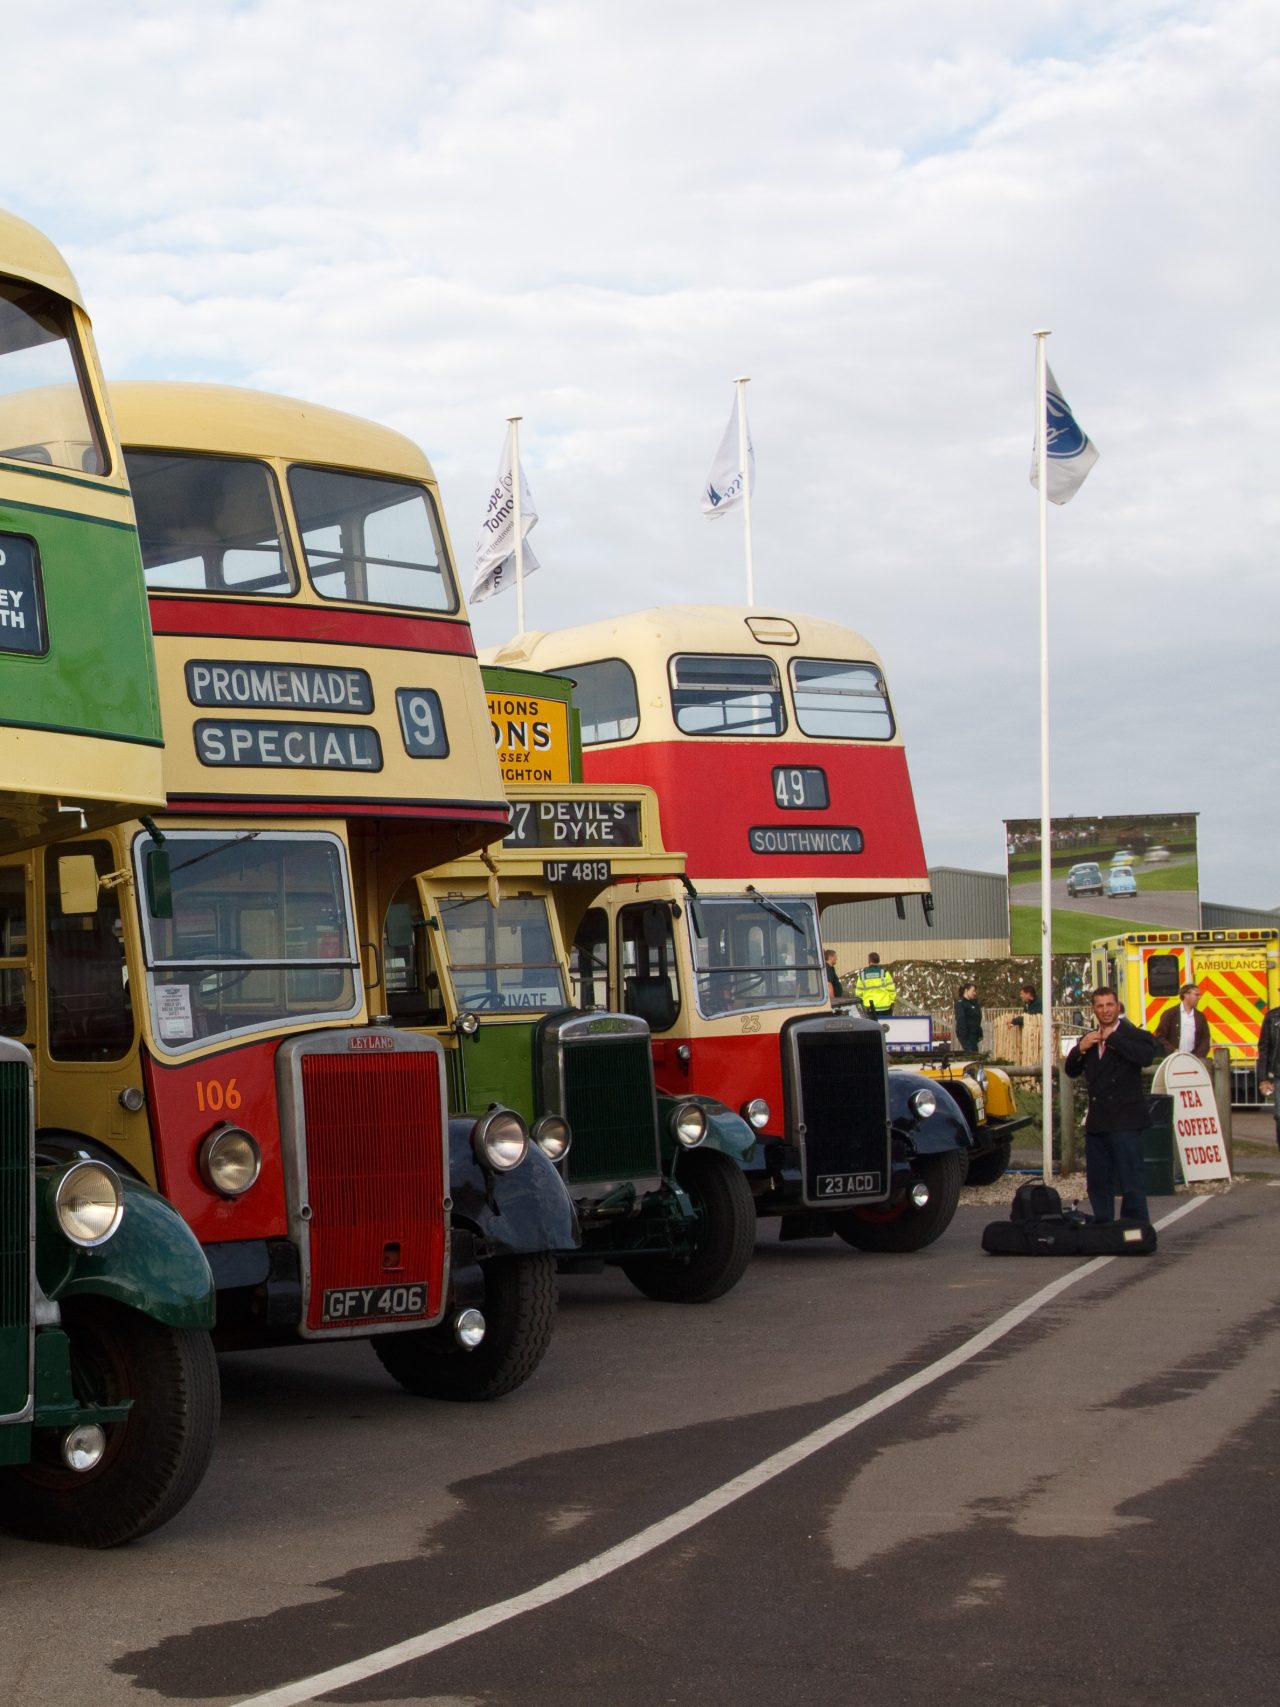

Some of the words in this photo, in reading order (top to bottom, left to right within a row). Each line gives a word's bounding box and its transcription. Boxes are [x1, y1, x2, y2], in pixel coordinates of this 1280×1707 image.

[483, 494, 514, 533] Tomo
[192, 667, 364, 706] PROMENADE
[201, 728, 373, 765] SPECIAL
[776, 770, 805, 806] 49
[540, 802, 626, 820] DEVIL'S
[553, 821, 615, 841] DYKE
[754, 831, 853, 852] SOUTHWICK
[547, 863, 568, 882] UF
[572, 862, 608, 881] 4813
[1196, 960, 1266, 971] AMBULANCE
[499, 993, 547, 1007] RIVATE
[740, 1015, 762, 1033] 23
[349, 1036, 395, 1050] LEYLAND
[196, 1078, 242, 1112] 106
[1179, 1090, 1203, 1109] TEA
[1177, 1116, 1218, 1138] COFFEE
[1184, 1145, 1222, 1165] FUDGE
[825, 1177, 843, 1194] 23
[847, 1176, 874, 1192] ACD
[329, 1289, 374, 1317] GFY
[377, 1287, 423, 1313] 406
